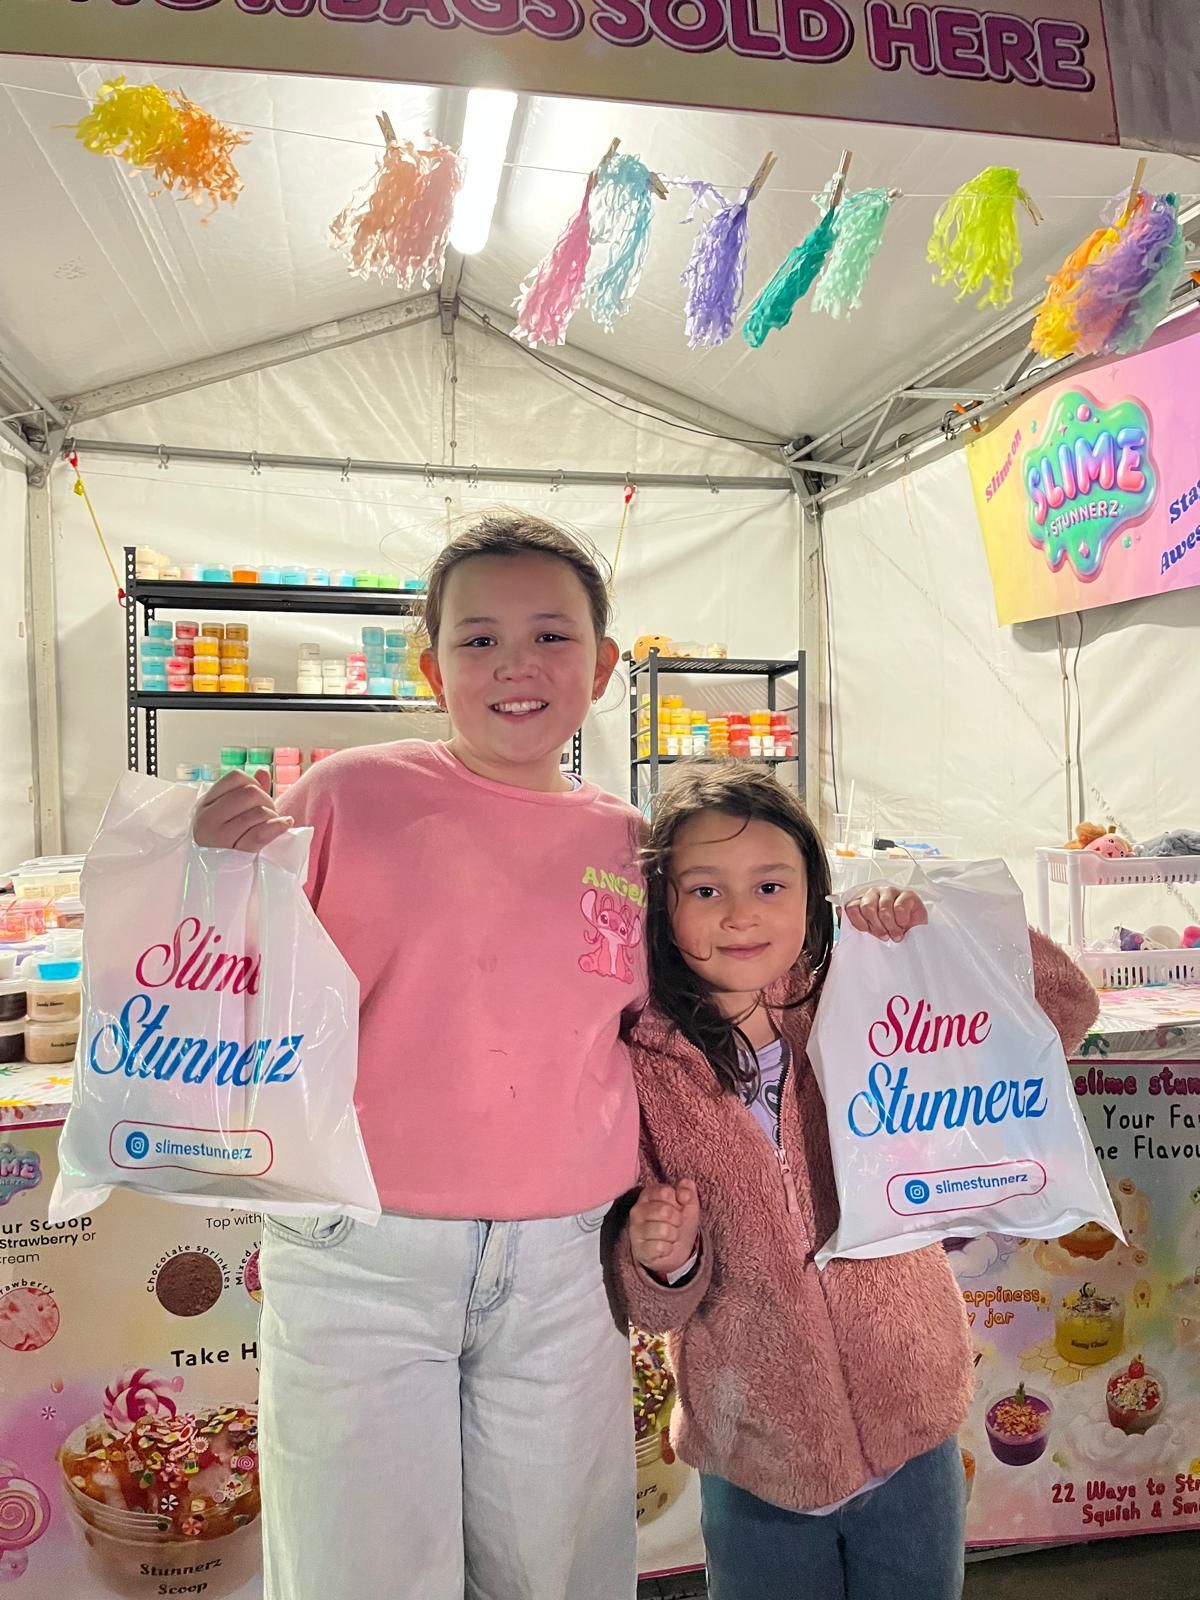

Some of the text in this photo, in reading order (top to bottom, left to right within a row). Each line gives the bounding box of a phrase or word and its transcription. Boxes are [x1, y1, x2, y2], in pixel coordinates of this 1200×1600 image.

[590, 0, 853, 64] SOLD
[864, 0, 1095, 92] HERE
[1028, 427, 1146, 526] SLIME
[1169, 480, 1200, 524] Sta
[1050, 500, 1119, 537] STUNNERZ
[868, 995, 992, 1057] Slime
[1074, 1067, 1137, 1095] slime
[848, 1062, 1048, 1137] Stunnerz
[1103, 1104, 1200, 1130] Your Fa
[155, 1139, 253, 1160] slimestunnerz
[935, 1172, 1028, 1194] slimestunnerz
[206, 1213, 261, 1230] Top with
[0, 1231, 96, 1249] Strawberry or
[0, 1253, 40, 1264] ream
[146, 1245, 231, 1293] Chocolate sprinkles
[984, 1308, 1014, 1328] jar
[170, 1347, 230, 1367] Take
[1051, 1482, 1076, 1503] 22
[1086, 1481, 1136, 1501] Ways
[1146, 1477, 1166, 1495] to
[1082, 1495, 1200, 1527] Squish & Sm
[140, 1558, 222, 1576] Stunnerz
[158, 1582, 208, 1595] Scoop
